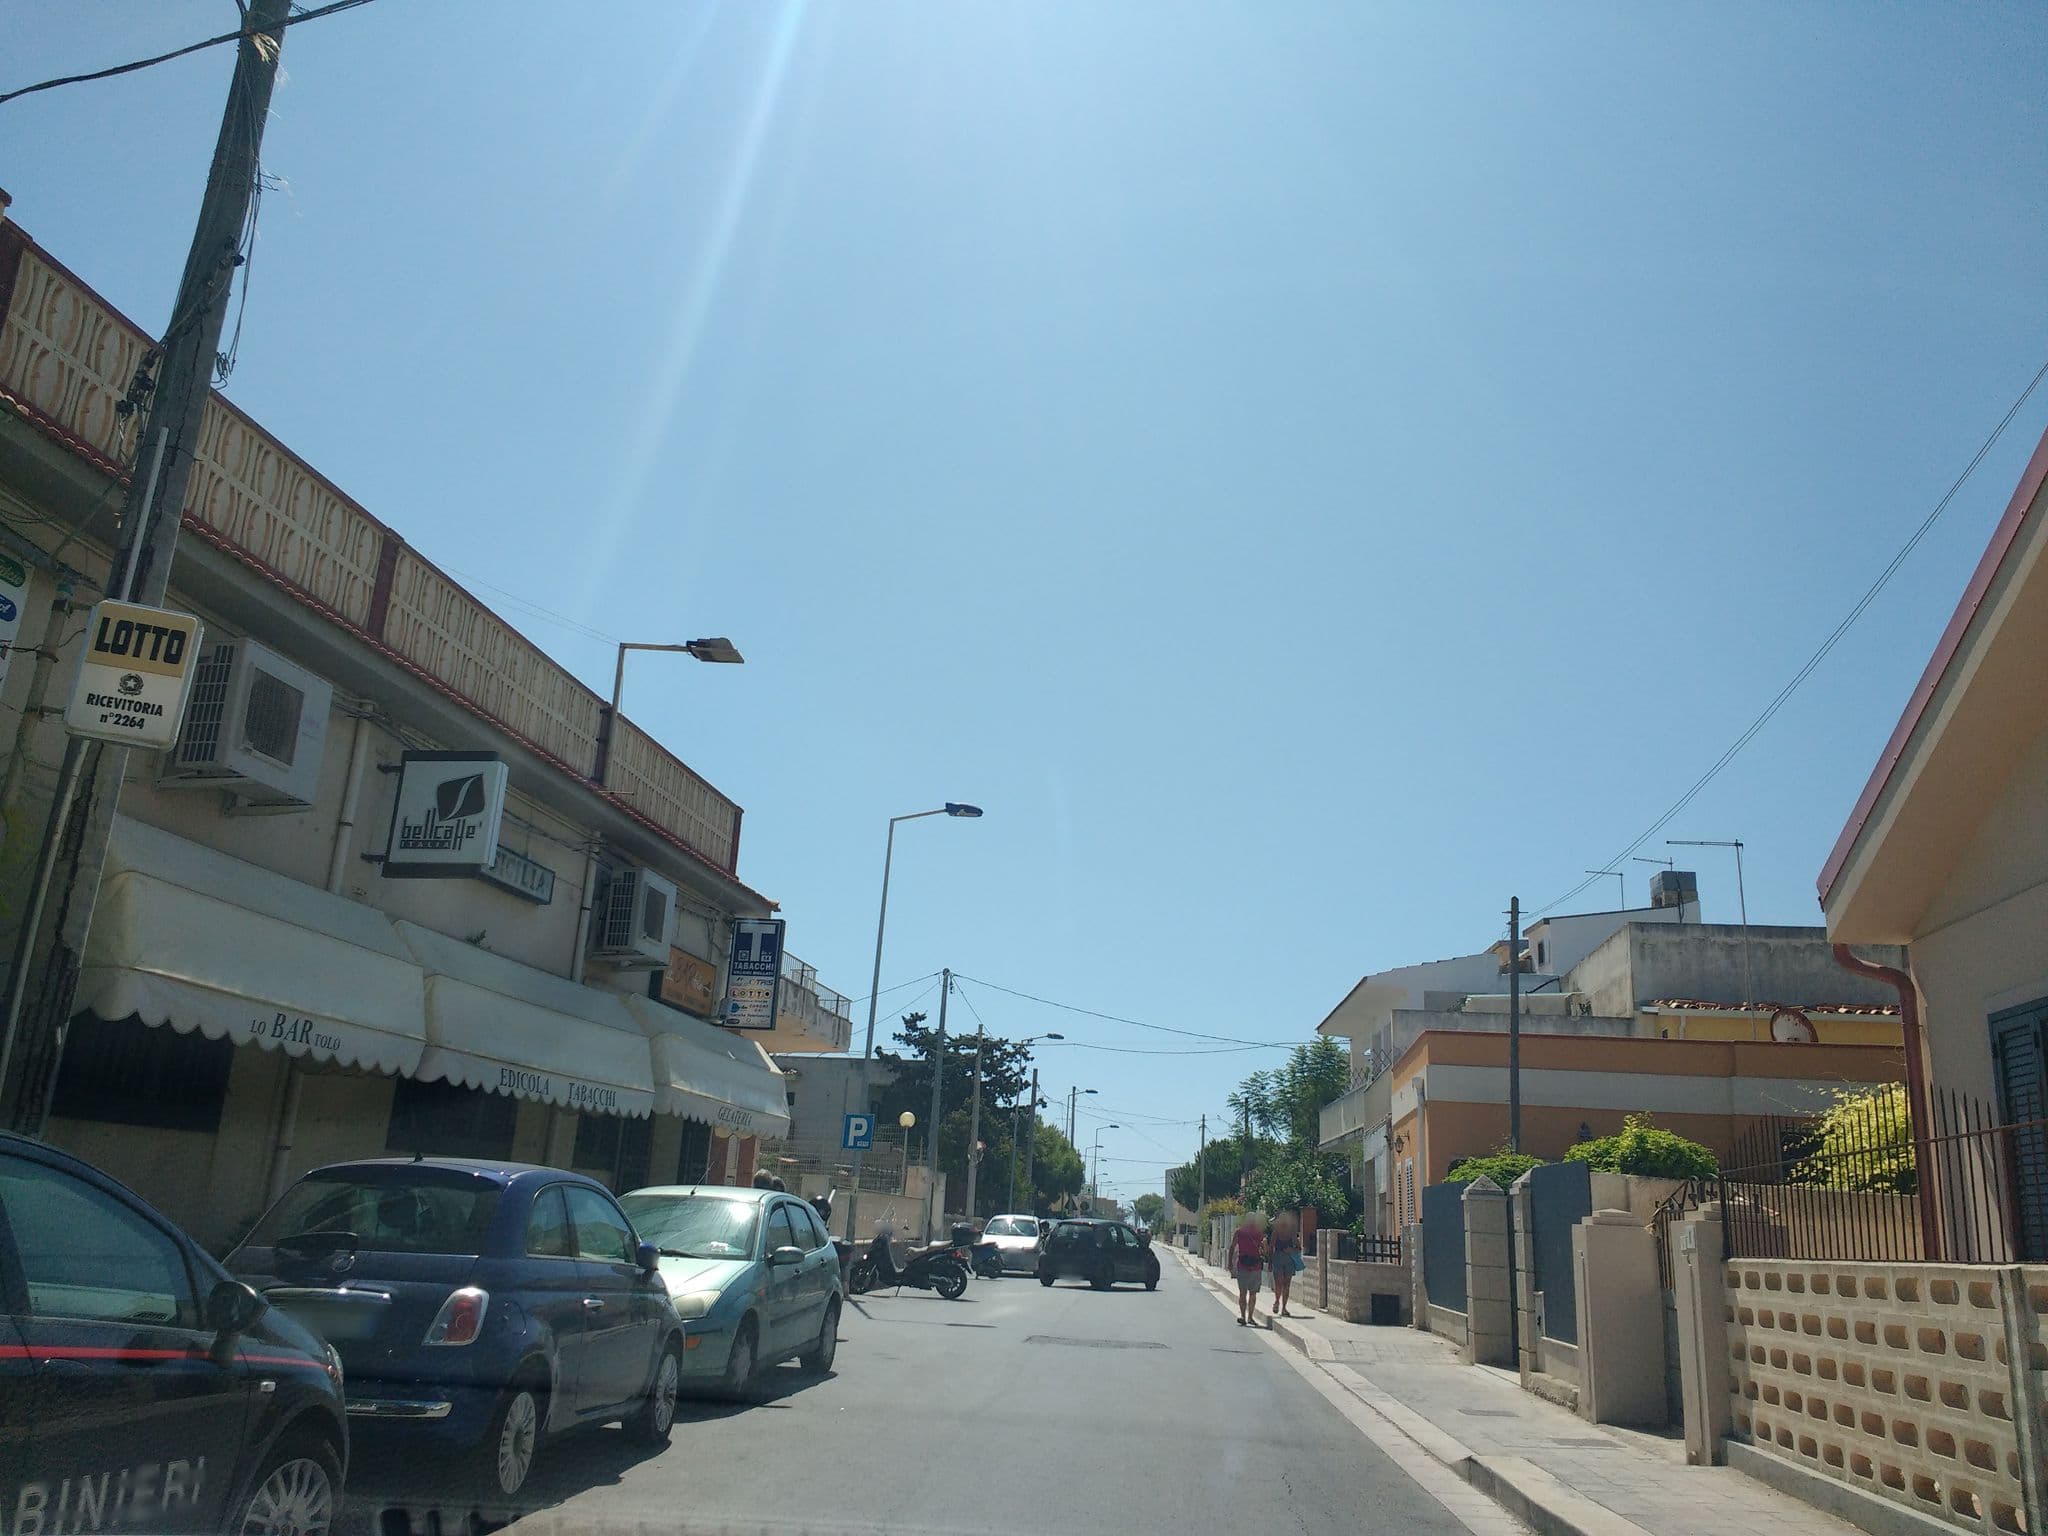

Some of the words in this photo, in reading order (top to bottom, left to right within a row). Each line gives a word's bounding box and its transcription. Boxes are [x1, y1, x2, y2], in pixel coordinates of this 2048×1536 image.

[94, 616, 187, 665] LOTTO
[86, 693, 163, 717] RICEVITORIA
[99, 712, 146, 730] n°2264
[401, 840, 450, 848] ITALIA
[740, 923, 776, 961] T
[734, 961, 774, 971] TABACCHI
[731, 989, 771, 998] LOTTO
[249, 1019, 266, 1035] LO
[271, 1012, 313, 1045] BAR
[500, 1067, 550, 1096] EDICOLA
[568, 1082, 617, 1107] TABACCHI
[848, 1117, 868, 1147] P
